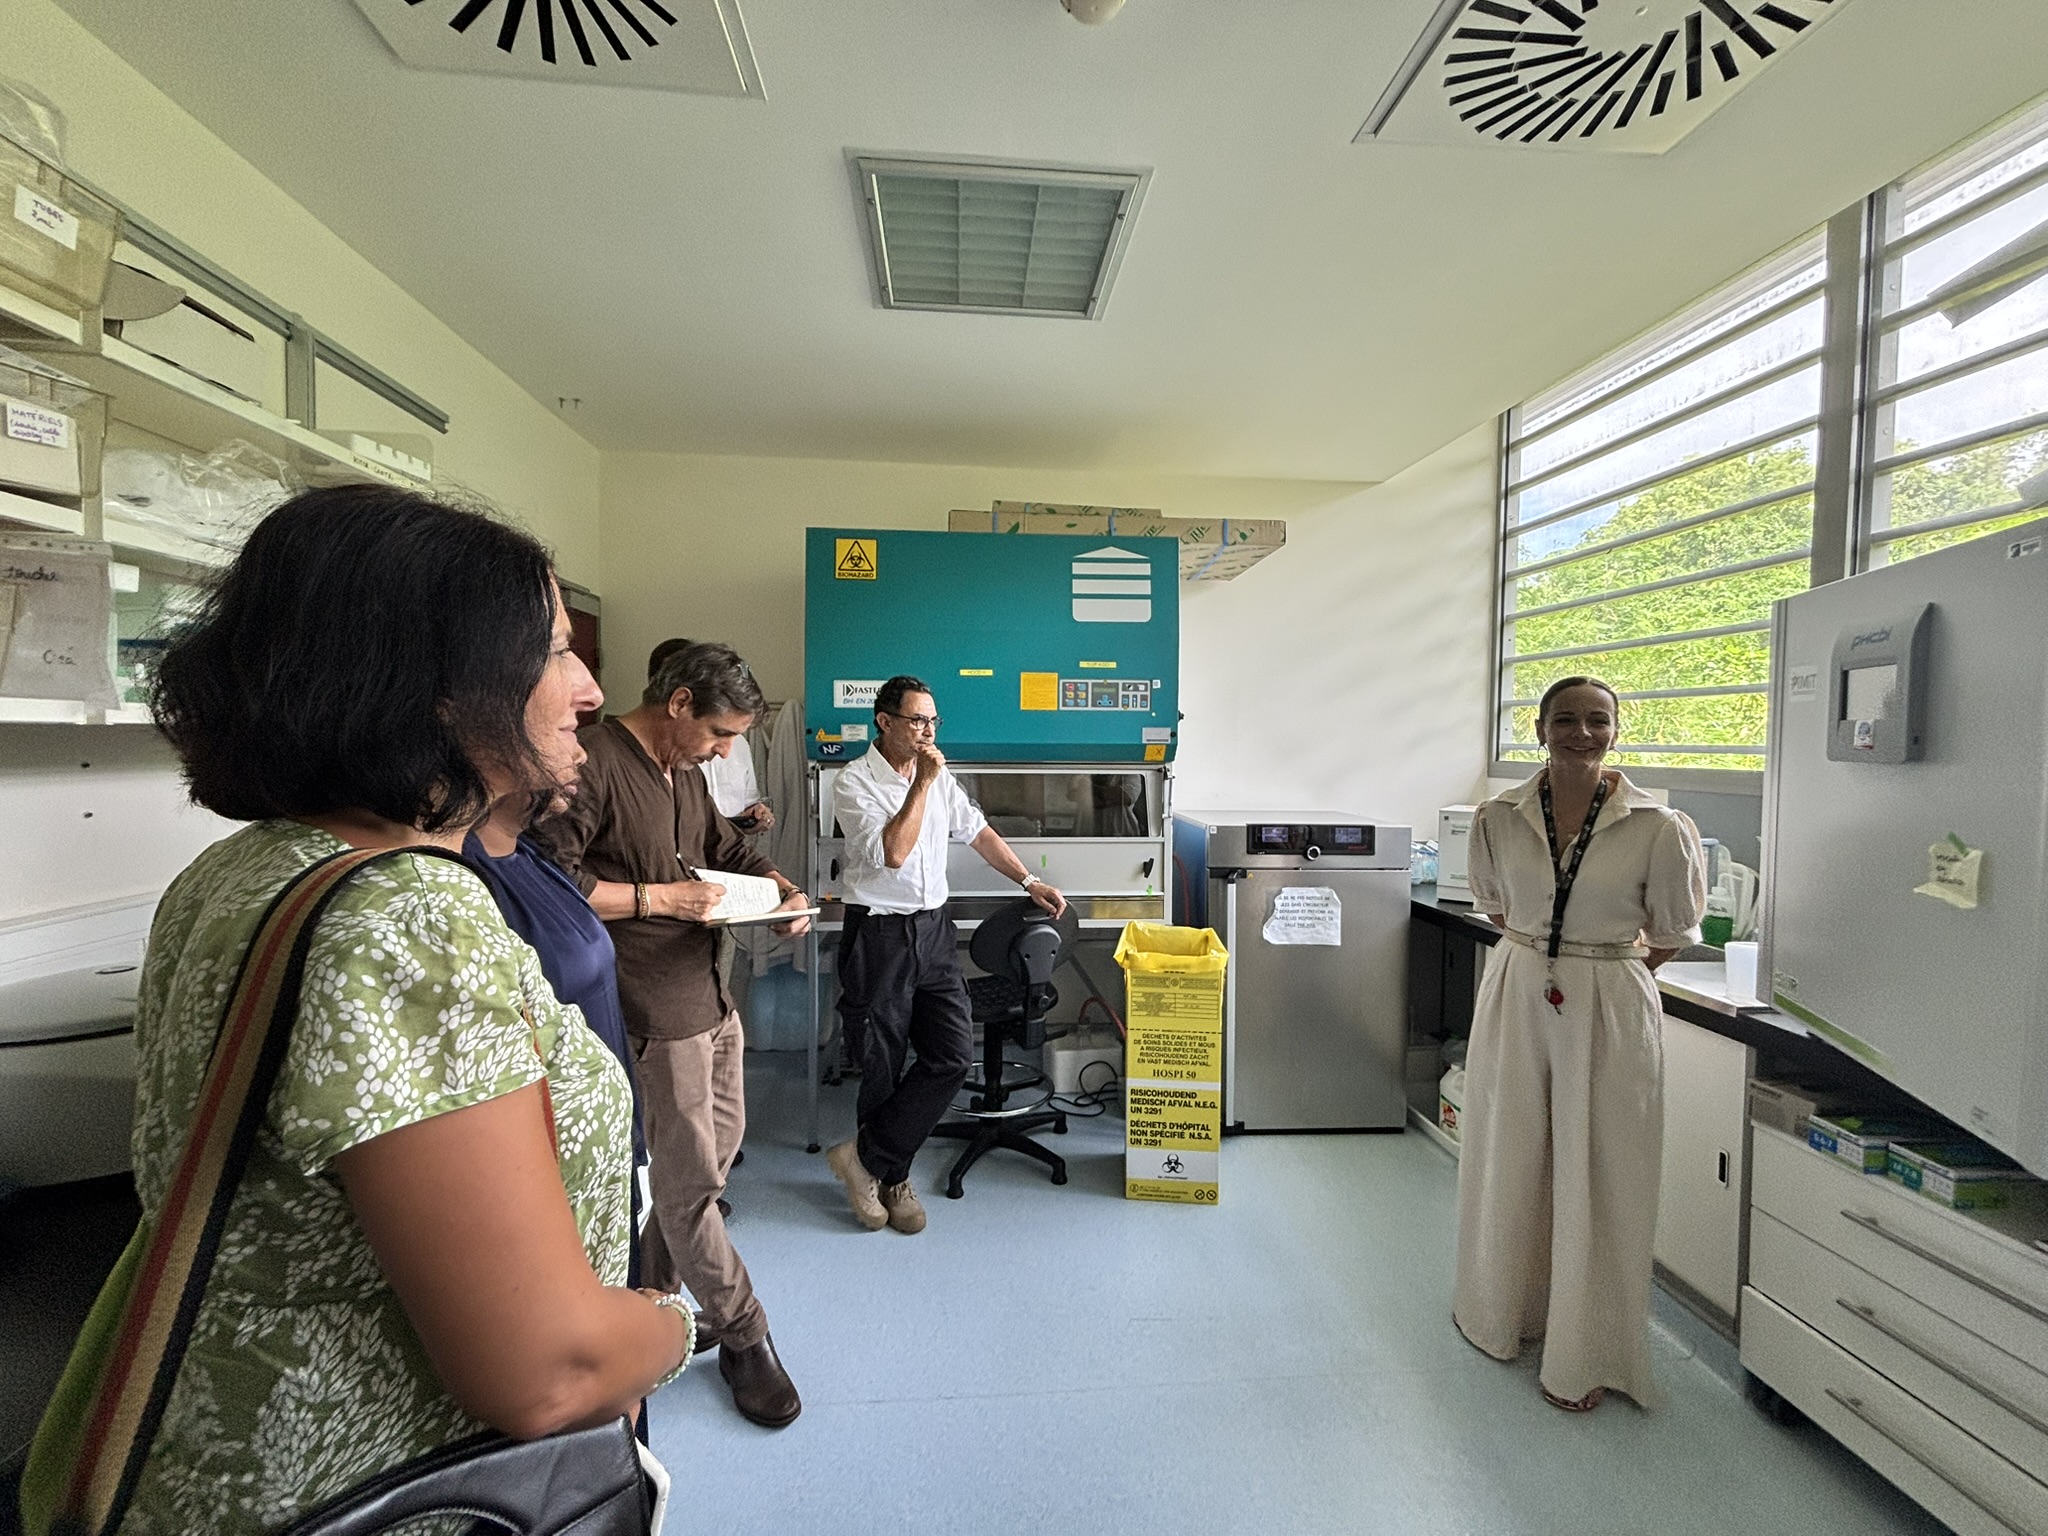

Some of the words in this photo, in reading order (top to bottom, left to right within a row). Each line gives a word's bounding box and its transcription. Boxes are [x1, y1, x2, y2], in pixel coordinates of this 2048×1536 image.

[823, 744, 841, 754] NF
[1153, 1069, 1184, 1078] HOSPI
[1186, 1071, 1197, 1079] 50
[1130, 1088, 1197, 1099] RISICOHOUDEND
[1130, 1098, 1166, 1106] MEDISCH
[1167, 1099, 1193, 1108] AFVAL
[1130, 1106, 1142, 1114] UN
[1144, 1107, 1162, 1115] 3291
[1130, 1119, 1167, 1129] DÉCHETS
[1169, 1121, 1211, 1131] D'HÔPITAL
[1130, 1129, 1148, 1137] NON
[1149, 1129, 1185, 1139] SPÉCIFIÉ
[1189, 1132, 1212, 1140] N.S.A.
[1130, 1137, 1142, 1145] UN
